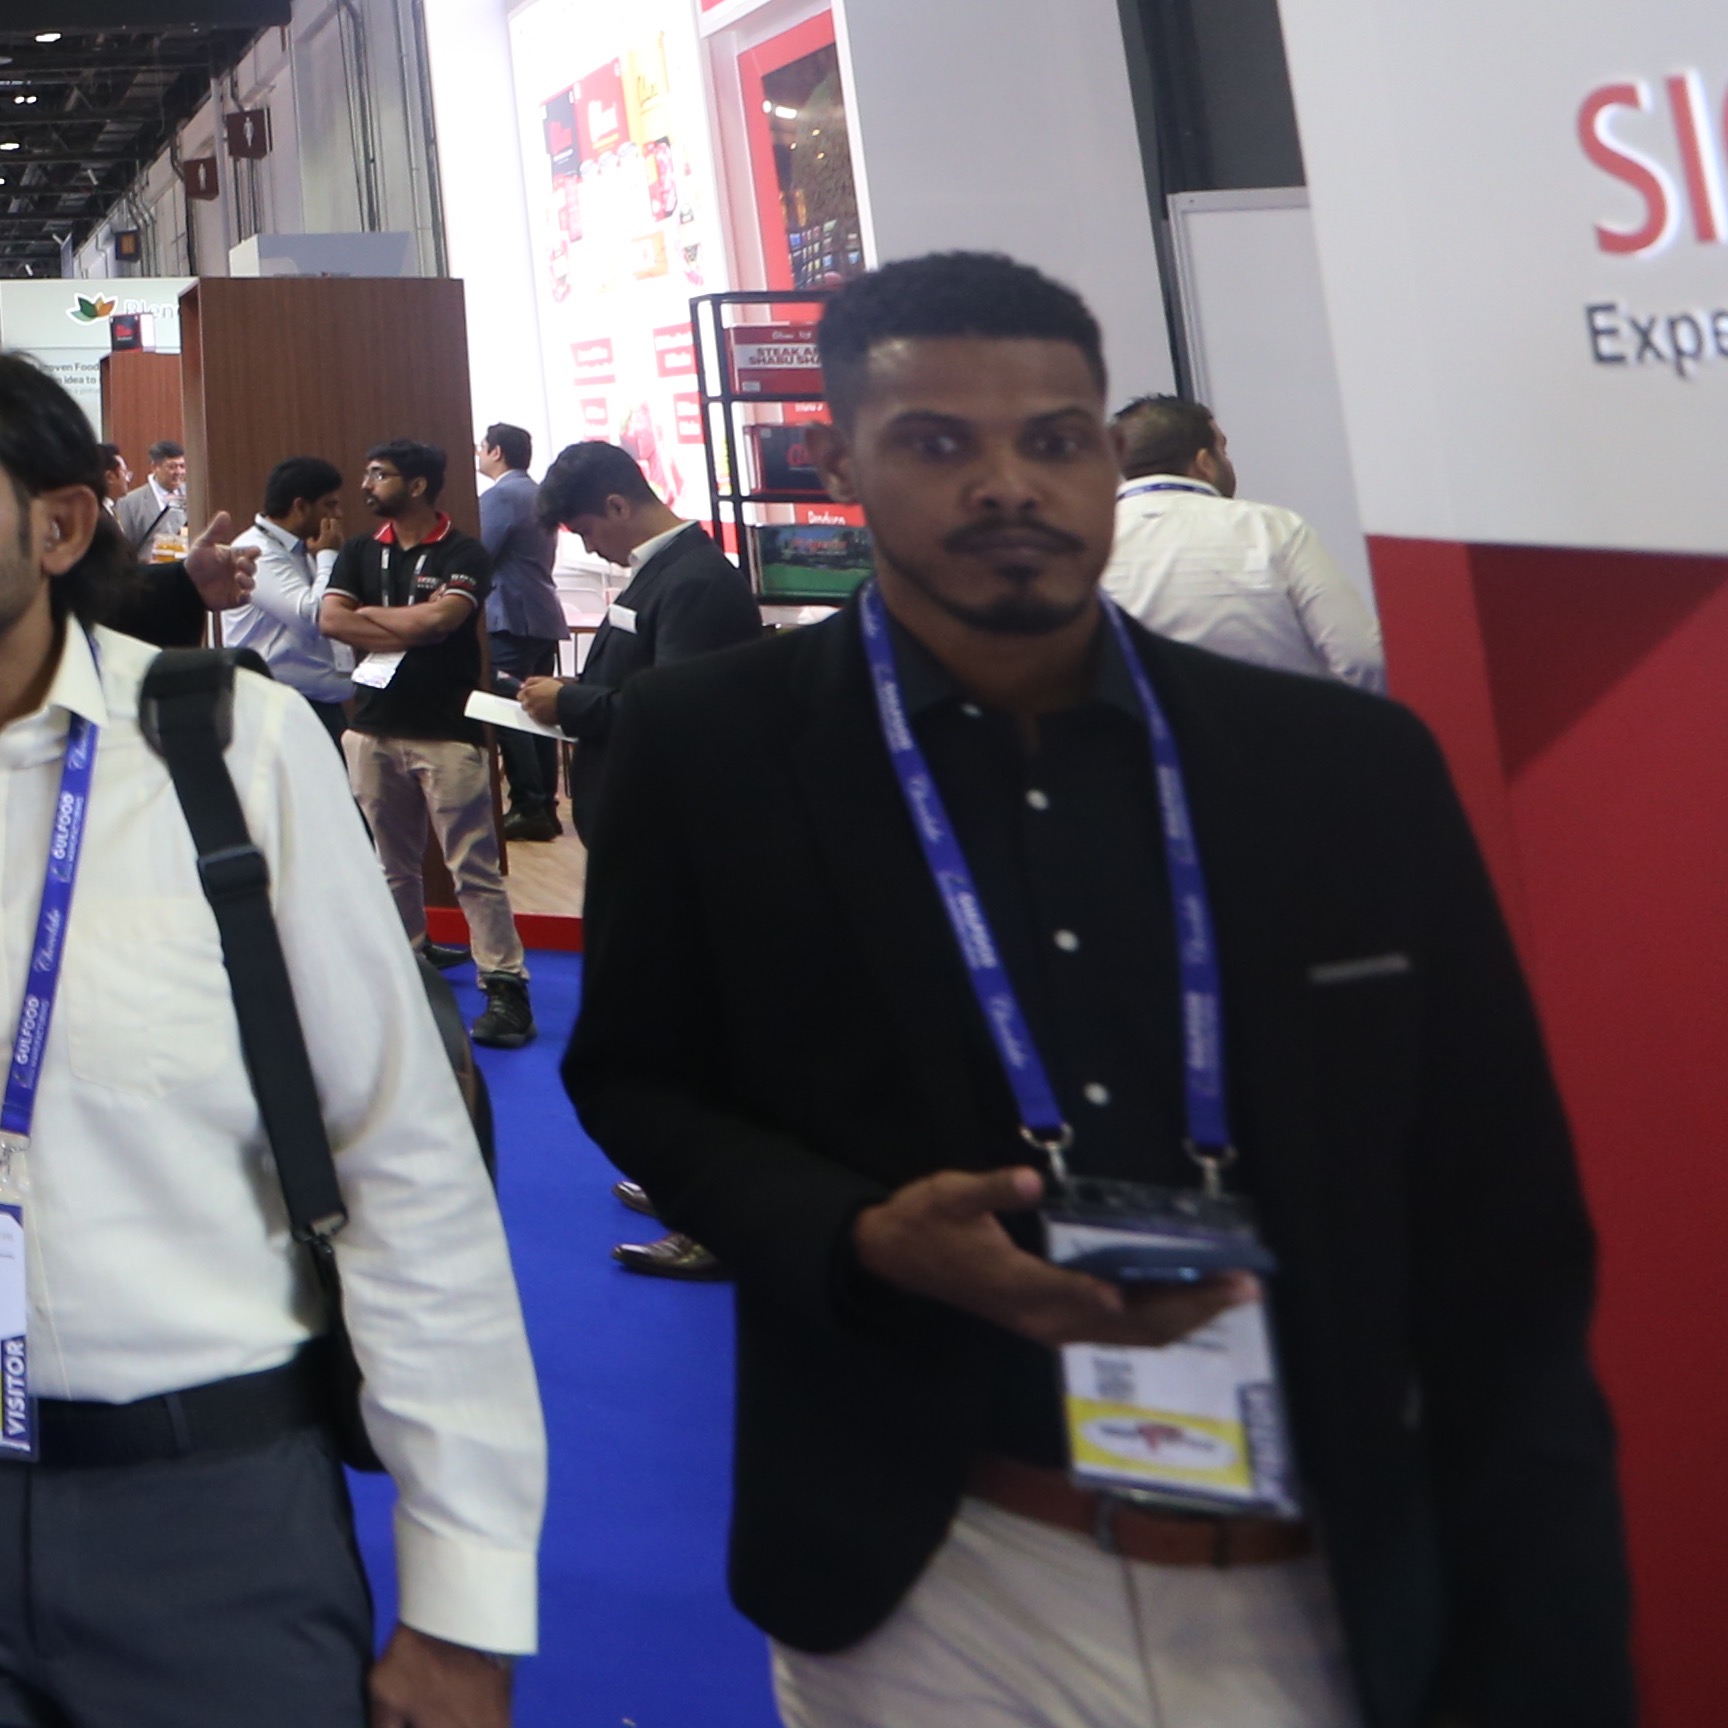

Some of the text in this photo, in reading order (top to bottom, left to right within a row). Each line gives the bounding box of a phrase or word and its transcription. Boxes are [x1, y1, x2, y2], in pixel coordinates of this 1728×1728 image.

[1578, 69, 1728, 256] SI
[52, 791, 75, 860] GULFOOD
[15, 995, 41, 1065] GULFOOD
[5, 1339, 26, 1437] VISITOR
